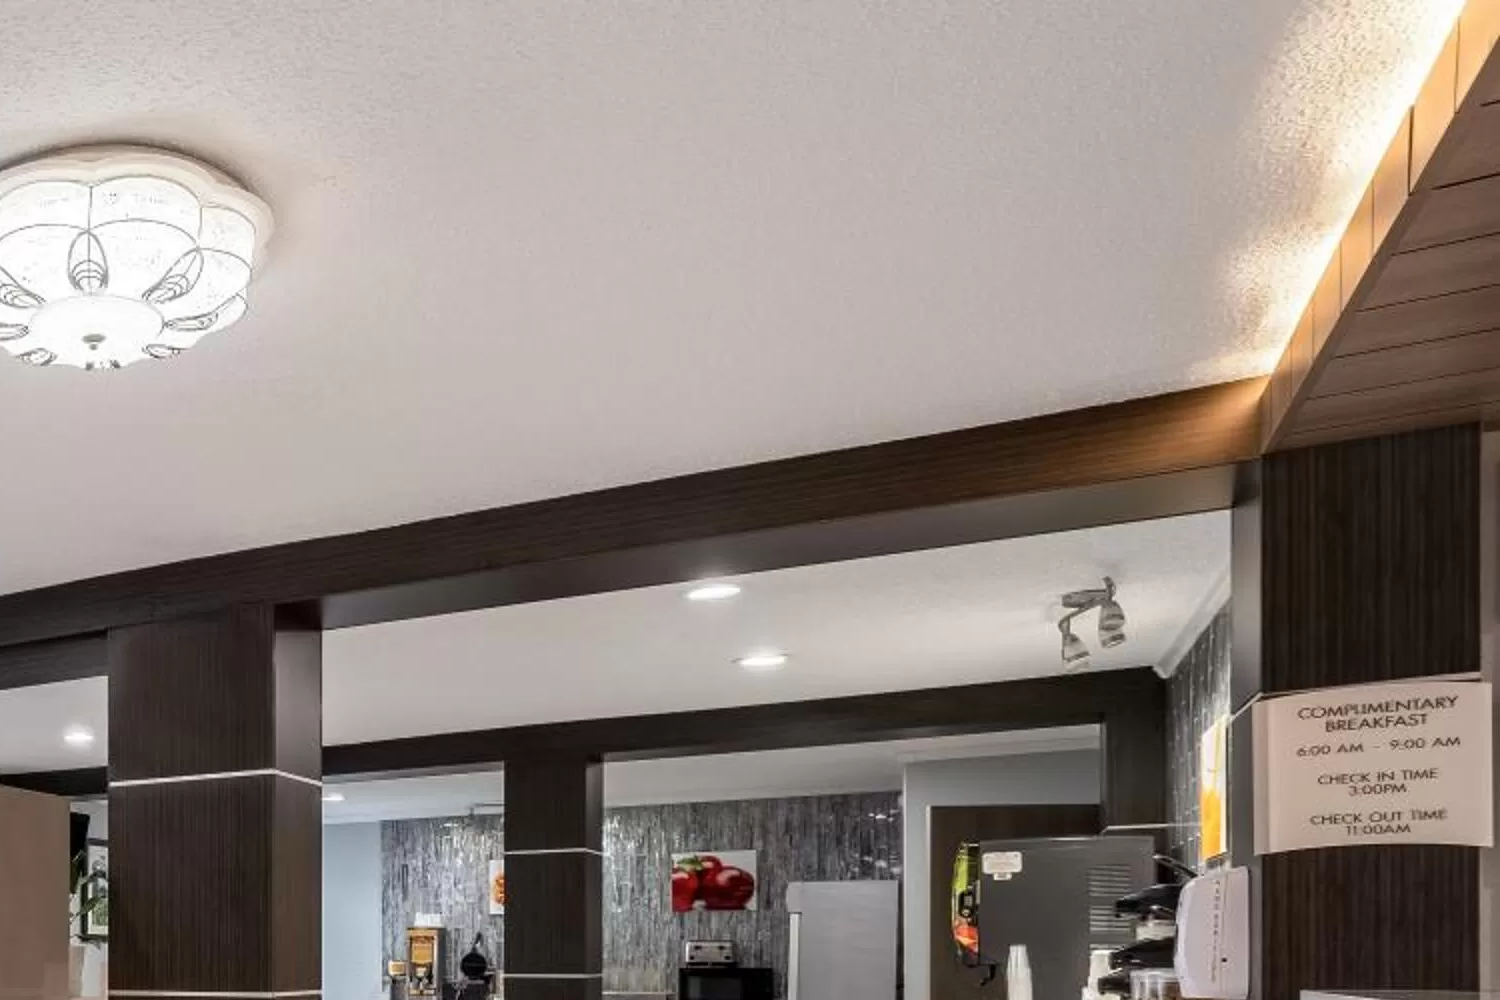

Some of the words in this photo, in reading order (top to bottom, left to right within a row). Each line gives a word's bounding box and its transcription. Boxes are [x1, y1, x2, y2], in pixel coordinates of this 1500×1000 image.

[1297, 695, 1459, 720] COMPLIMENTARY
[1325, 713, 1428, 733] BREAKFAST
[1296, 745, 1331, 758] 6:00
[1336, 742, 1364, 753] AM
[1388, 738, 1426, 750] 9:00
[1432, 736, 1461, 747] AM
[1317, 772, 1370, 786] CHECK
[1377, 770, 1395, 782] IN
[1402, 768, 1439, 781] TIME
[1348, 783, 1407, 797] 3:00PM
[1309, 813, 1362, 826] CHECK
[1368, 811, 1402, 823] OUT
[1410, 809, 1448, 821] TIME
[1345, 823, 1412, 836] 11:00AM
